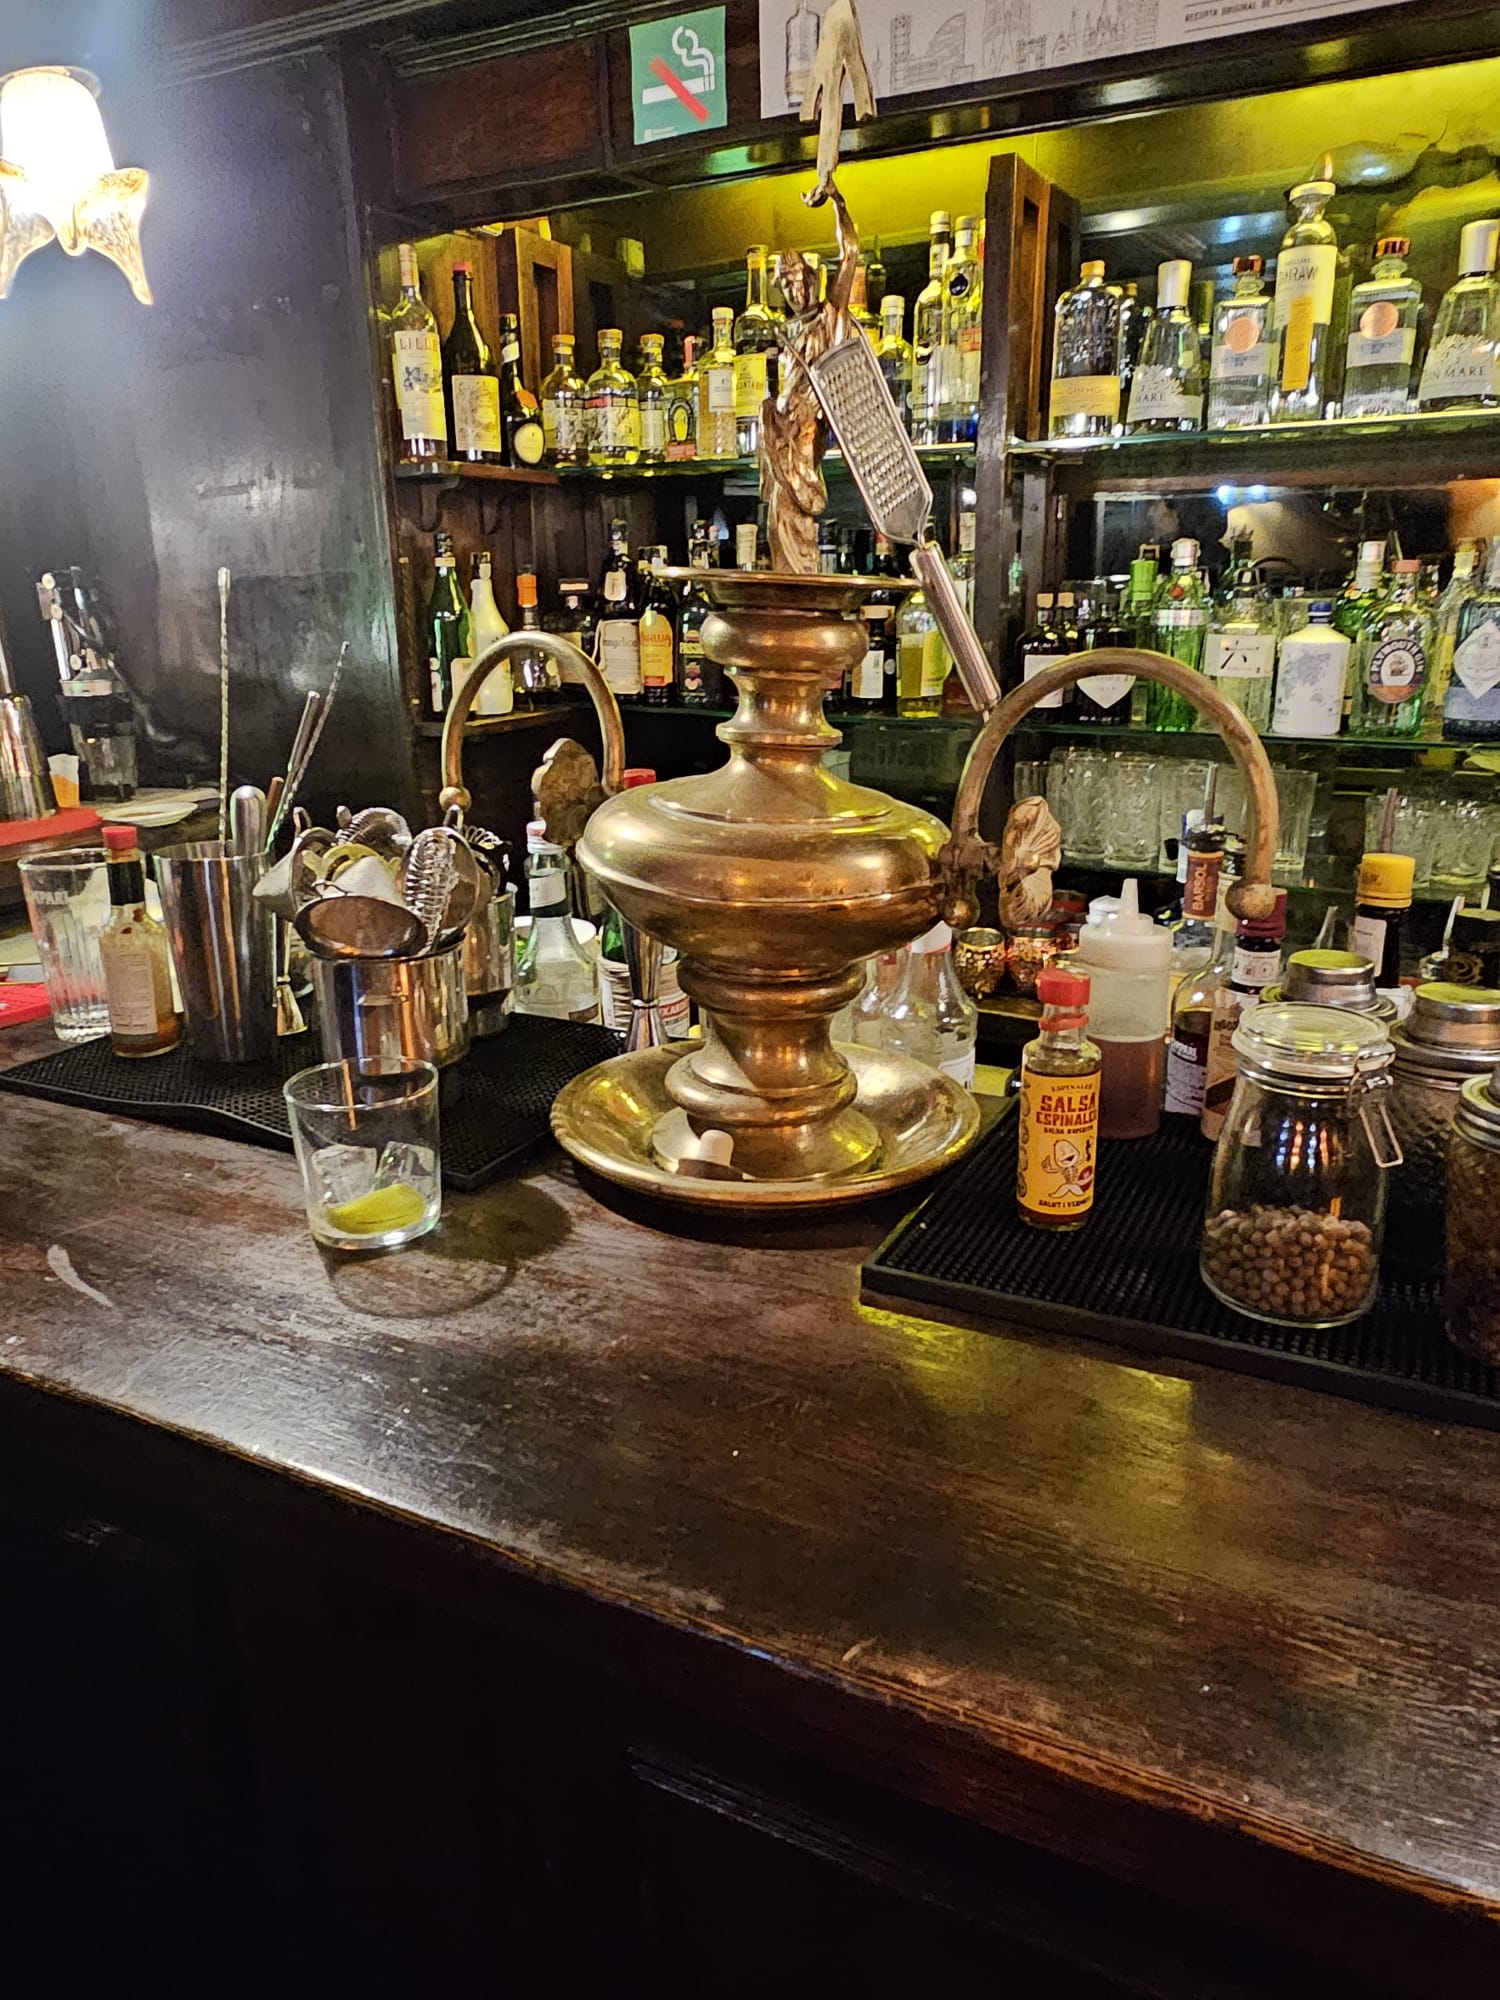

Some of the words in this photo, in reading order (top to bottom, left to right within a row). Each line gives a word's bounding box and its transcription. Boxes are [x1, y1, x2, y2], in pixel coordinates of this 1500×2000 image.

[399, 337, 439, 352] LILLE
[1443, 365, 1486, 379] MARE
[1370, 640, 1420, 672] PLYMOUTH
[1192, 862, 1207, 911] BARSOL
[1041, 1092, 1096, 1113] SALSA
